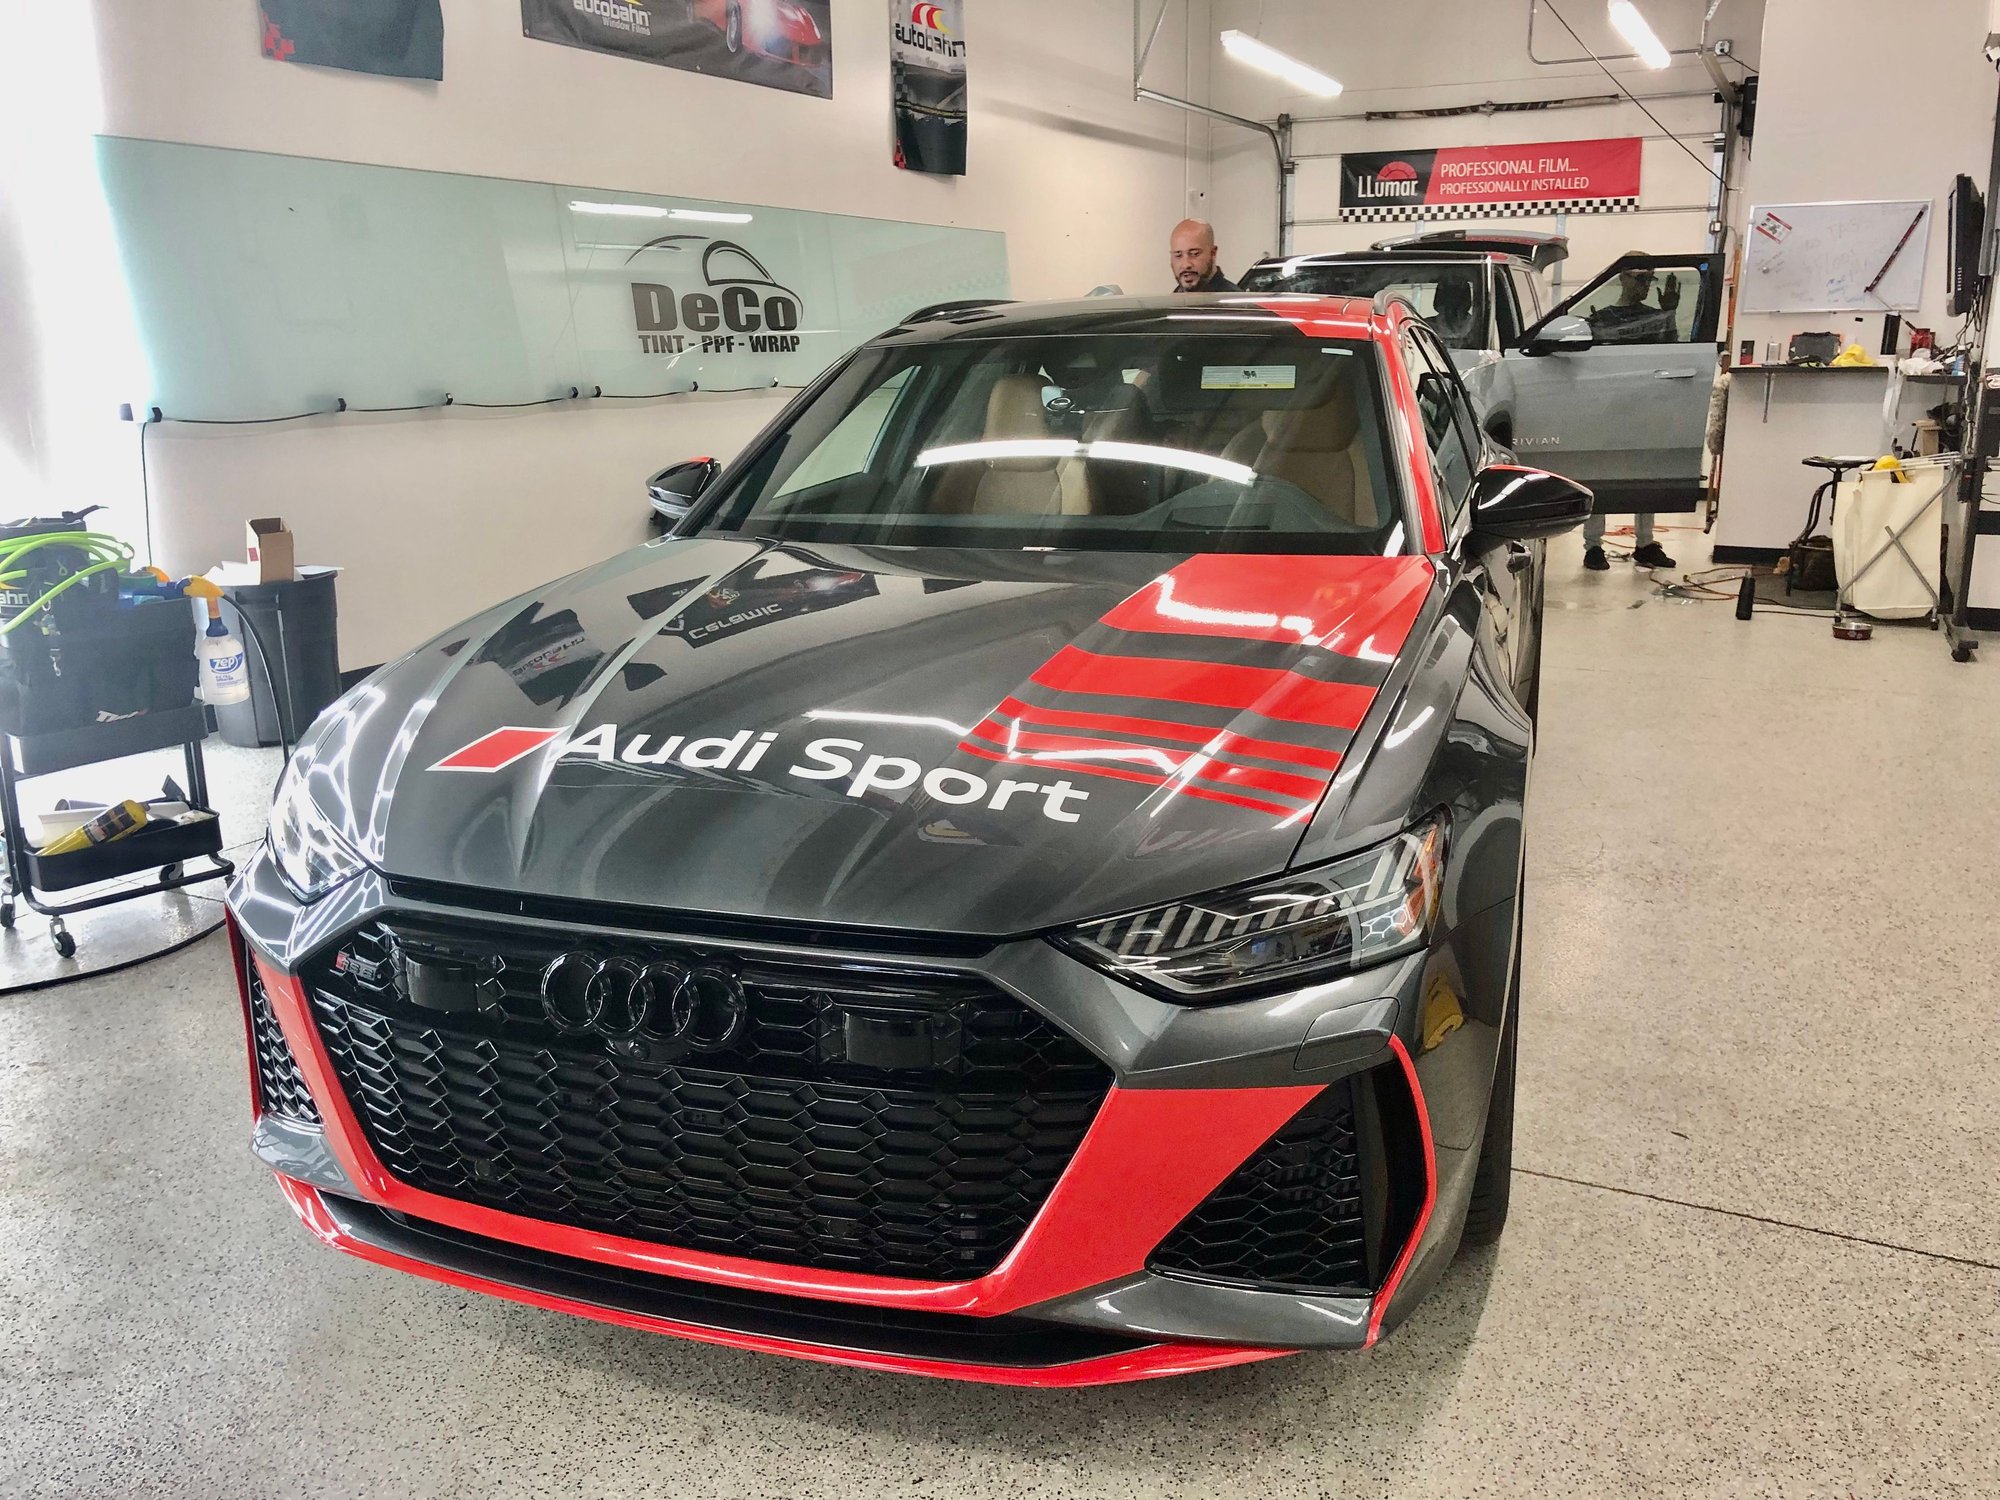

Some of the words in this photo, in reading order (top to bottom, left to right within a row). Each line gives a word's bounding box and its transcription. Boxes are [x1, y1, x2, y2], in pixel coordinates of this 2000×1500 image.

[601, 16, 630, 31] Window
[631, 22, 651, 36] Films
[895, 23, 966, 57] autobahn
[1440, 160, 1535, 178] PROFESSIONAL
[1538, 158, 1579, 174] FILM...
[1357, 175, 1419, 198] LLumar
[1439, 179, 1529, 195] PROFESSIONALLY
[1531, 176, 1590, 191] INSTALLED
[631, 282, 798, 333] DeCo
[638, 335, 684, 354] TINT
[702, 335, 735, 354] PPF
[749, 335, 800, 354] WRAP
[1511, 436, 1560, 446] RIVIAN
[551, 723, 779, 772] Audi
[789, 737, 1090, 823] Sport
